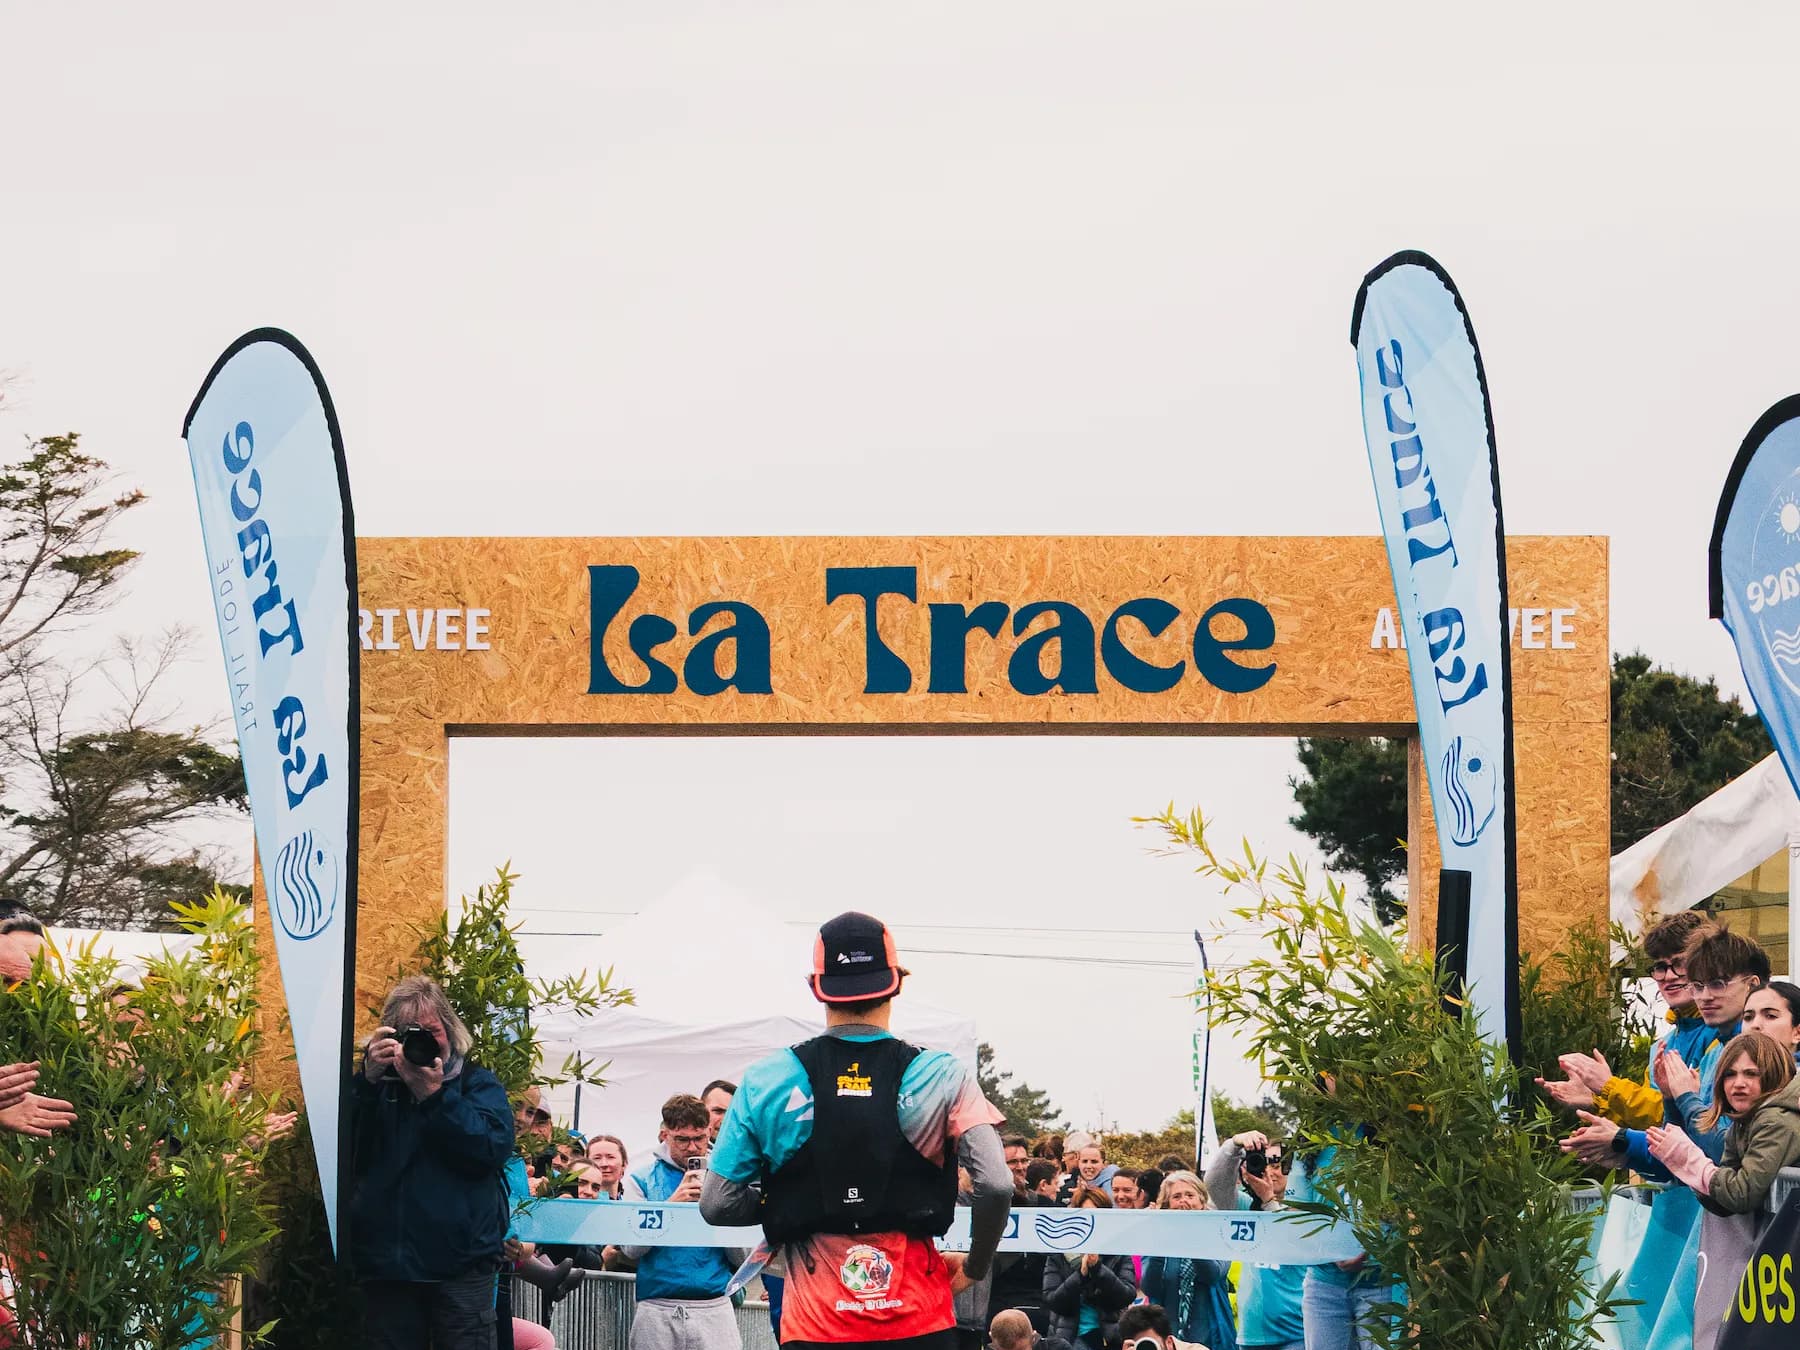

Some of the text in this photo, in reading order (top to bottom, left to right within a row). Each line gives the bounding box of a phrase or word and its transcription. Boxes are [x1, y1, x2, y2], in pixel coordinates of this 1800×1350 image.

[358, 608, 491, 650] RIVEE
[587, 564, 774, 696] La
[826, 566, 1277, 696] Trace
